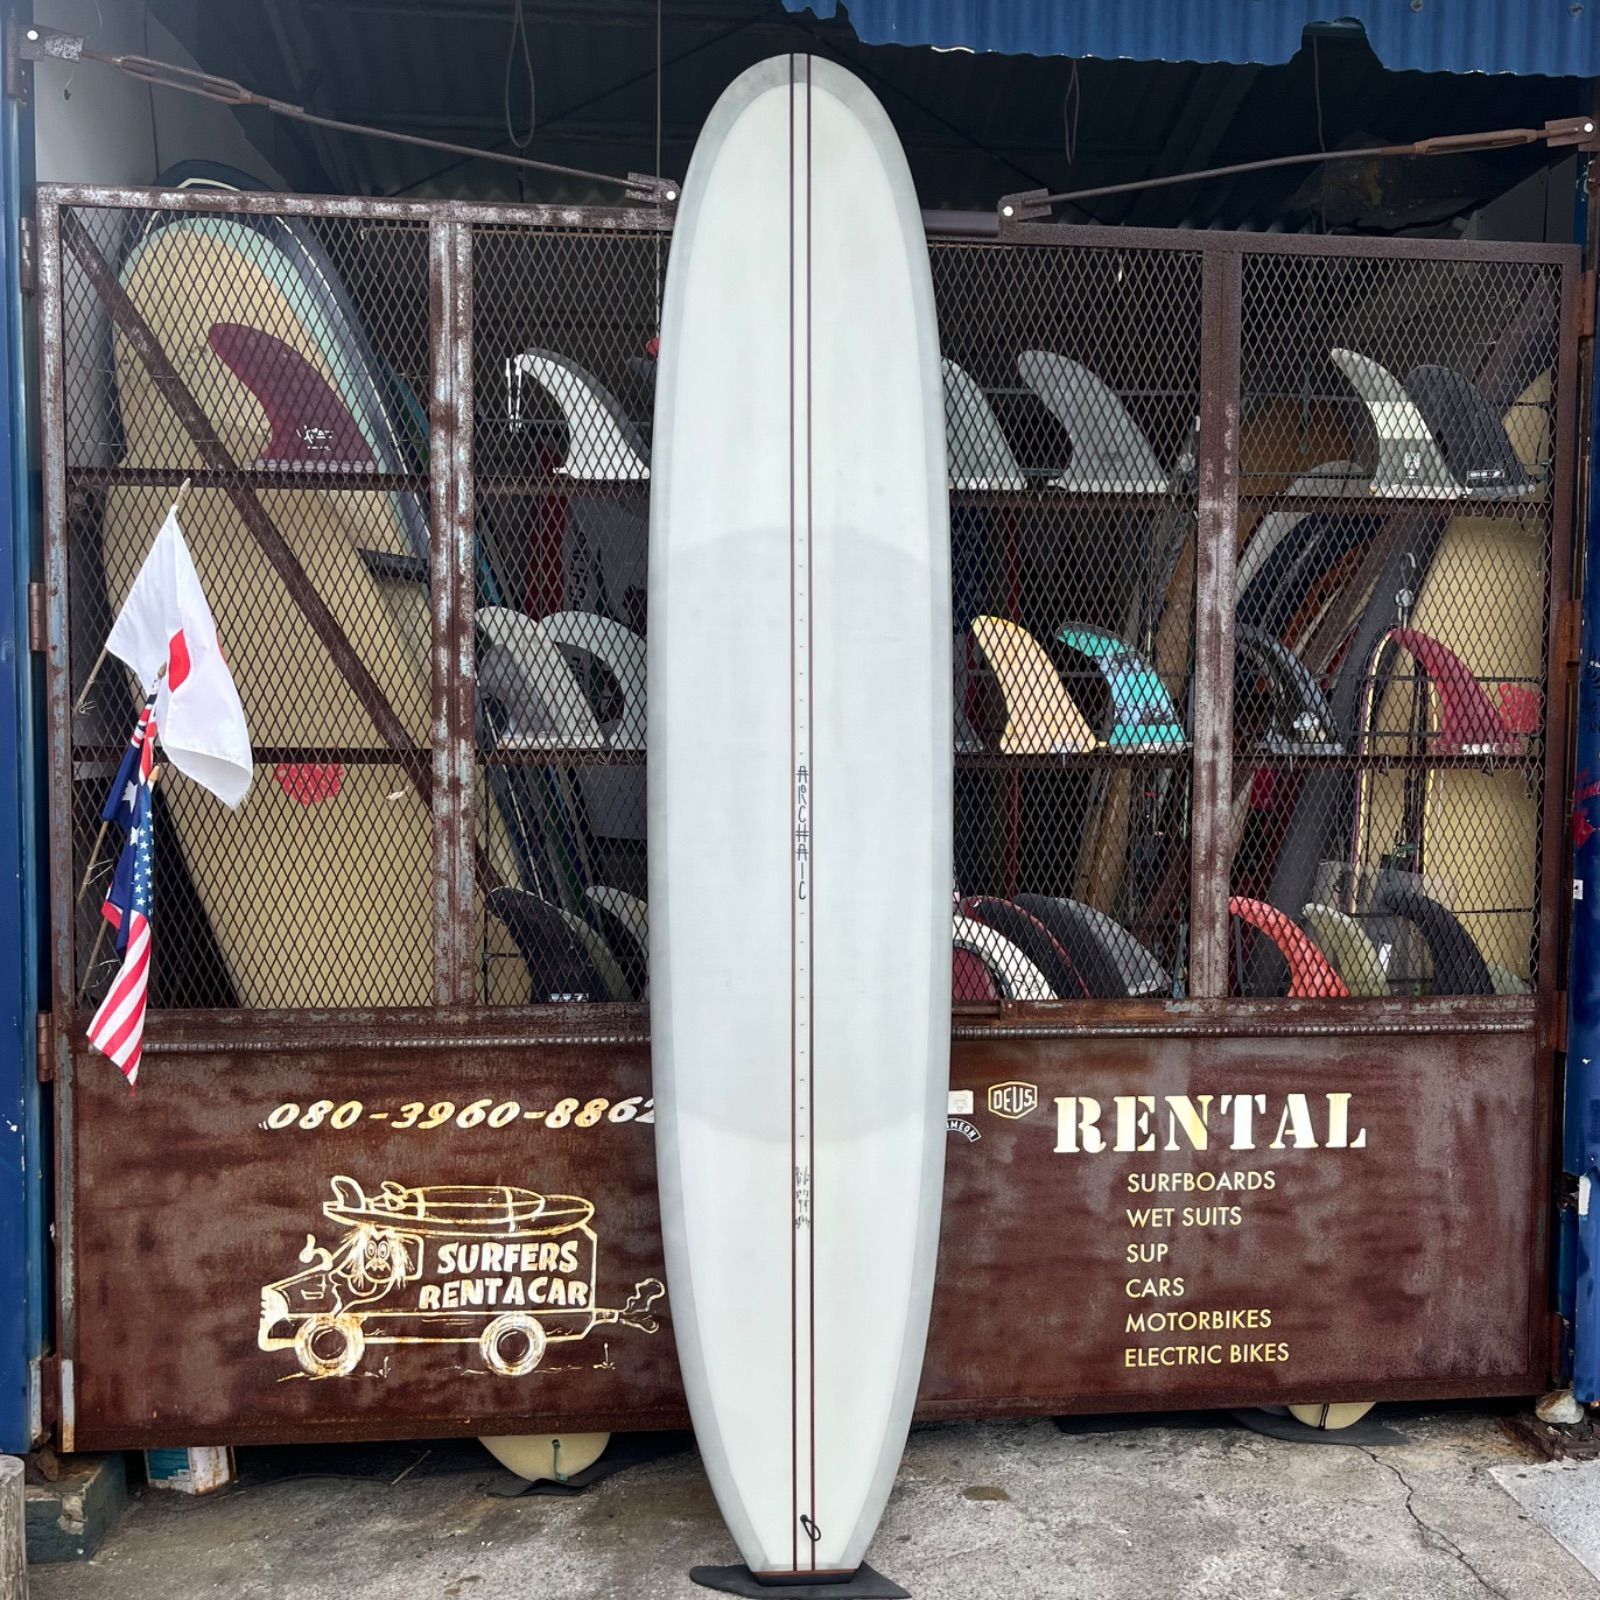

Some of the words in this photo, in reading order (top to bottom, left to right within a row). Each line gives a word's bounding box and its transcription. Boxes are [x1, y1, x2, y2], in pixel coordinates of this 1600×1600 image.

[1053, 1092, 1367, 1153] RENTAL
[1127, 1170, 1276, 1193] SURFBOARDS
[1126, 1207, 1175, 1228] WET
[1182, 1206, 1242, 1227] SUITS
[437, 1241, 578, 1274] SURFERS
[1126, 1243, 1169, 1263] SUP
[1125, 1277, 1185, 1298] CARS
[1125, 1309, 1272, 1333] MOTORBIKES
[1125, 1344, 1222, 1368] ELECTRIC
[1230, 1342, 1290, 1364] BIKES
